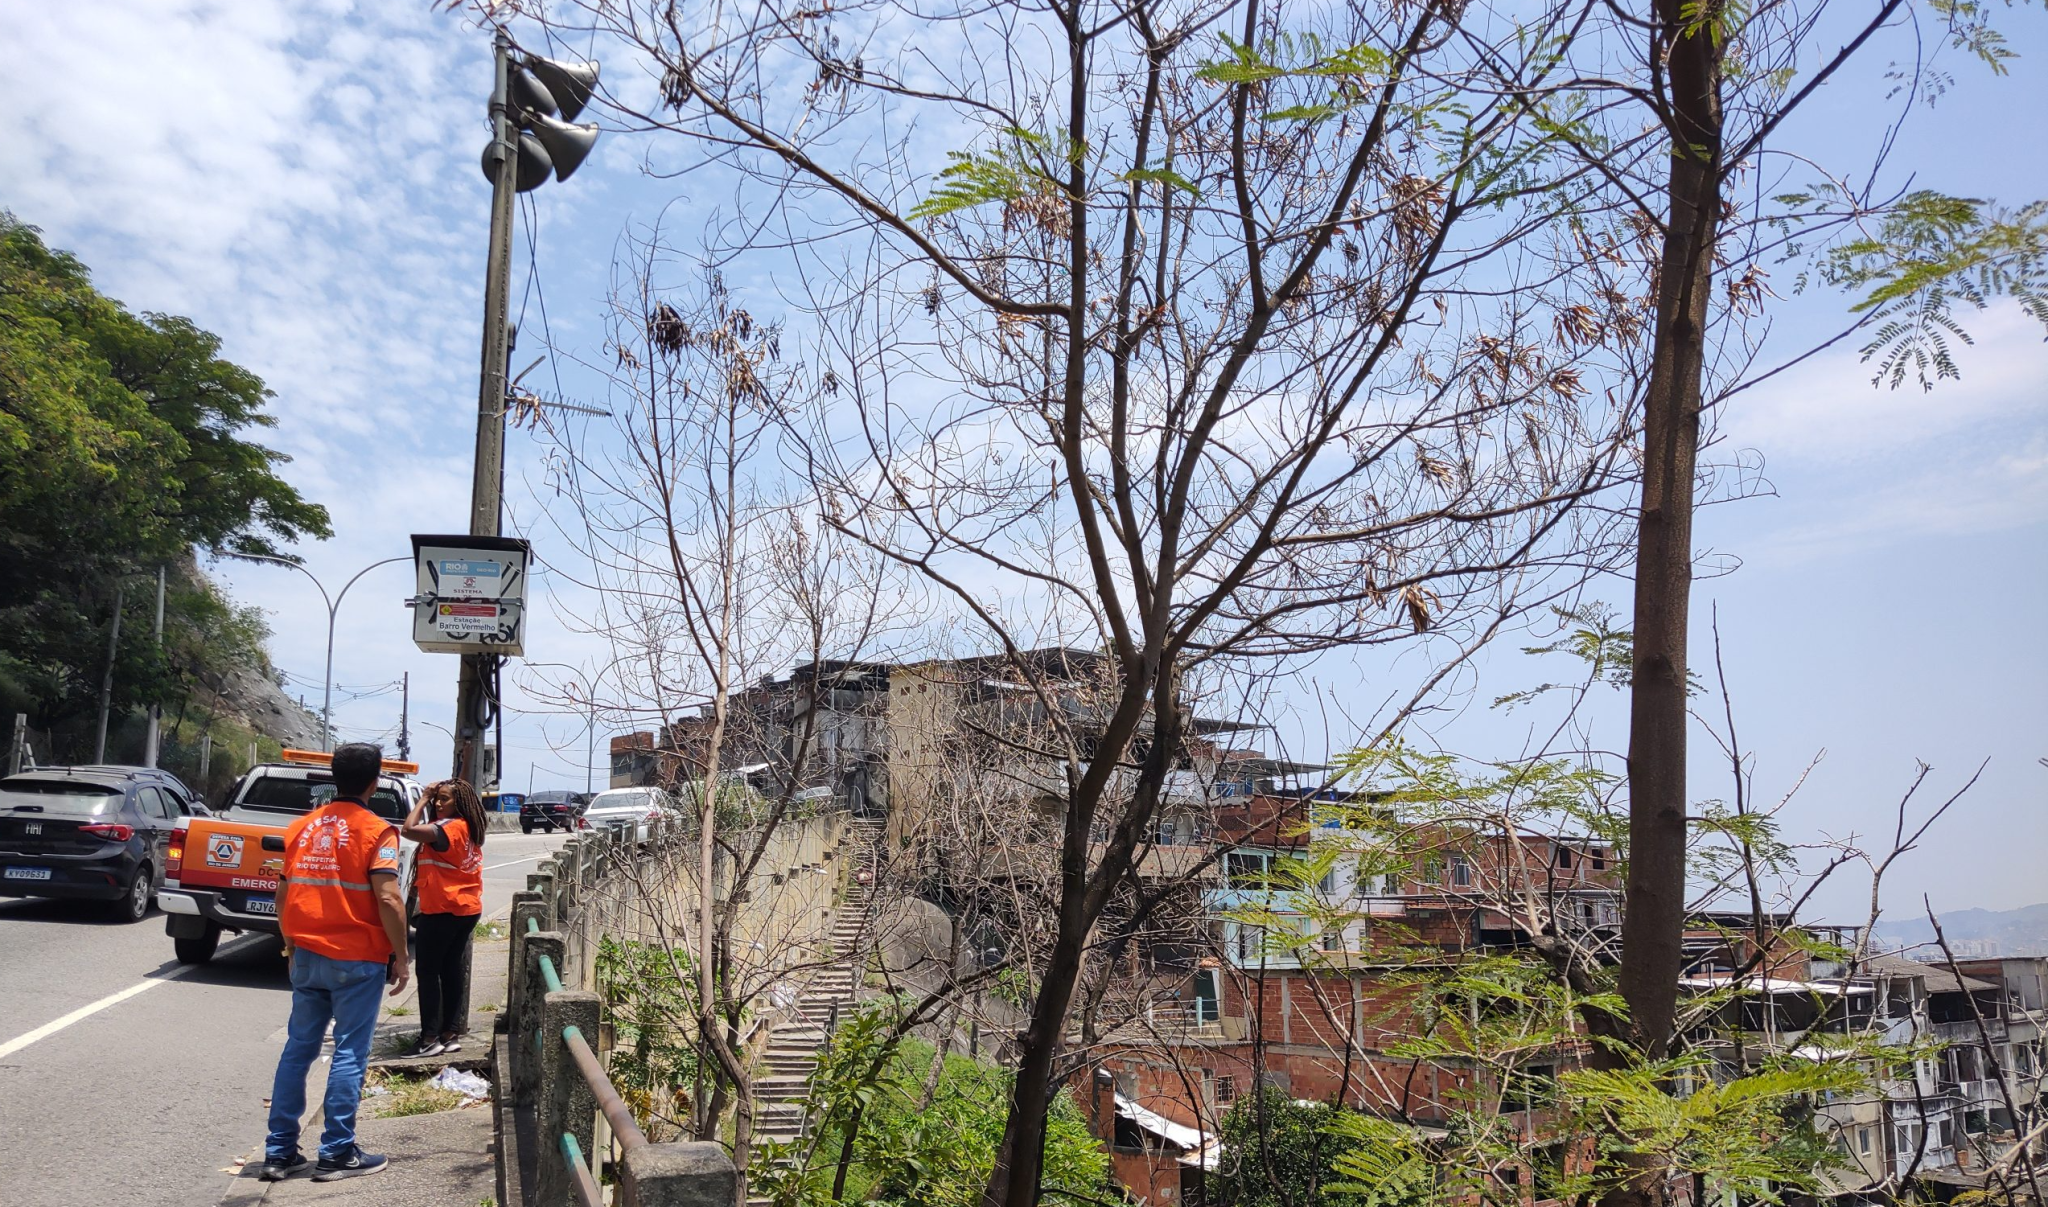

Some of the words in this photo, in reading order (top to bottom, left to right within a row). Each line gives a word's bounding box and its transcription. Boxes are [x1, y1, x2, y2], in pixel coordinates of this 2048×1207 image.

[461, 623, 496, 631] Vermelho
[25, 823, 43, 835] FIAT
[299, 815, 338, 847] DEFESA
[337, 819, 350, 849] CIVIL
[231, 878, 280, 889] EMERG
